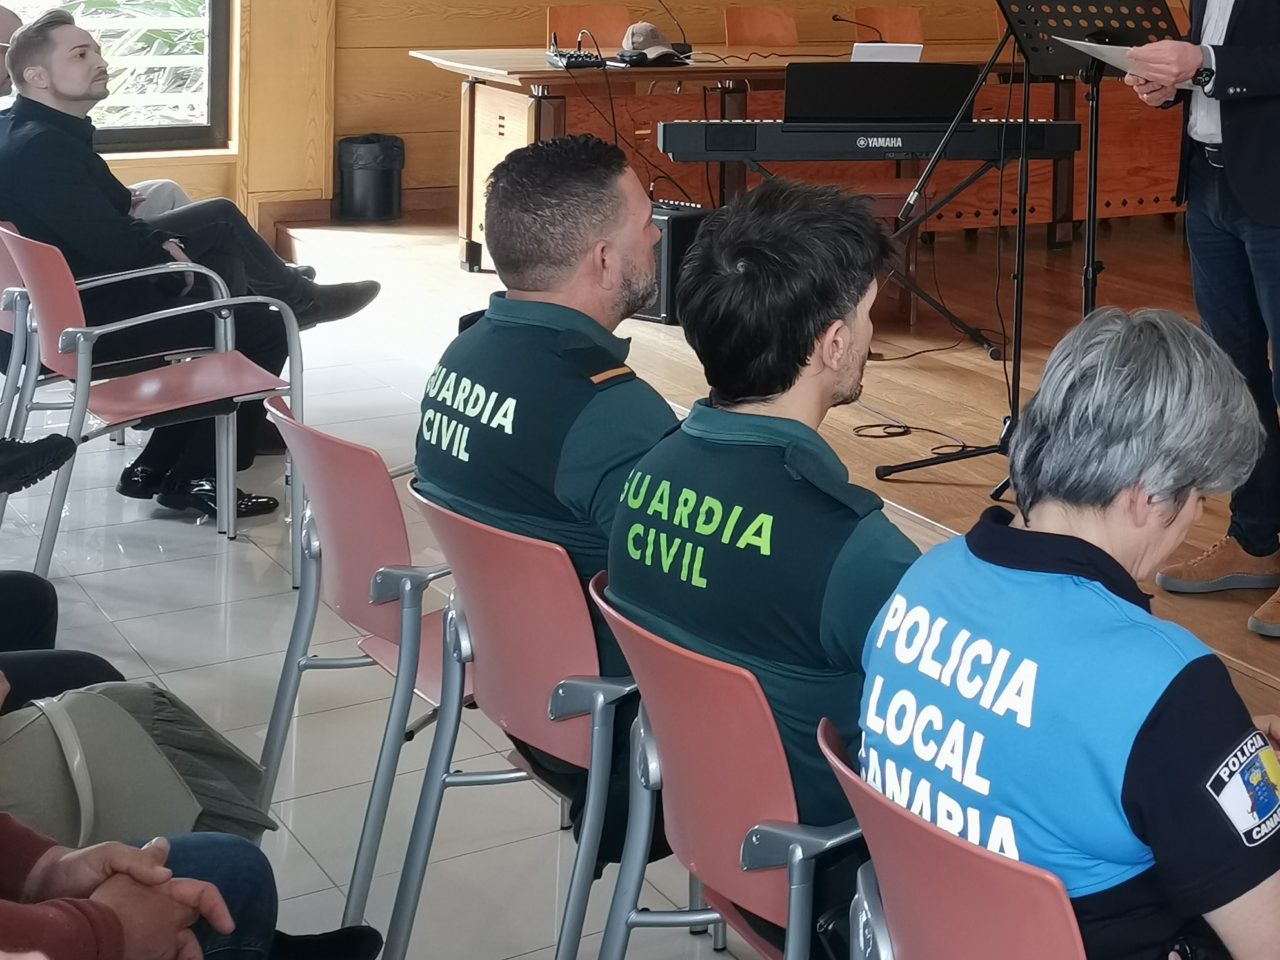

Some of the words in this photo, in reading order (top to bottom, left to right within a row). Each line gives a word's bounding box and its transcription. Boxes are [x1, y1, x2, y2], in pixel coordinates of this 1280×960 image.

[867, 137, 903, 148] YAMAHA
[422, 408, 470, 463] CIVIL
[620, 469, 774, 556] UARDIA
[627, 523, 707, 589] CIVIL
[876, 593, 1039, 728] POLICIA
[866, 674, 991, 797] LOCAL
[1219, 734, 1265, 782] POLICIA
[858, 732, 1020, 861] ANARIA
